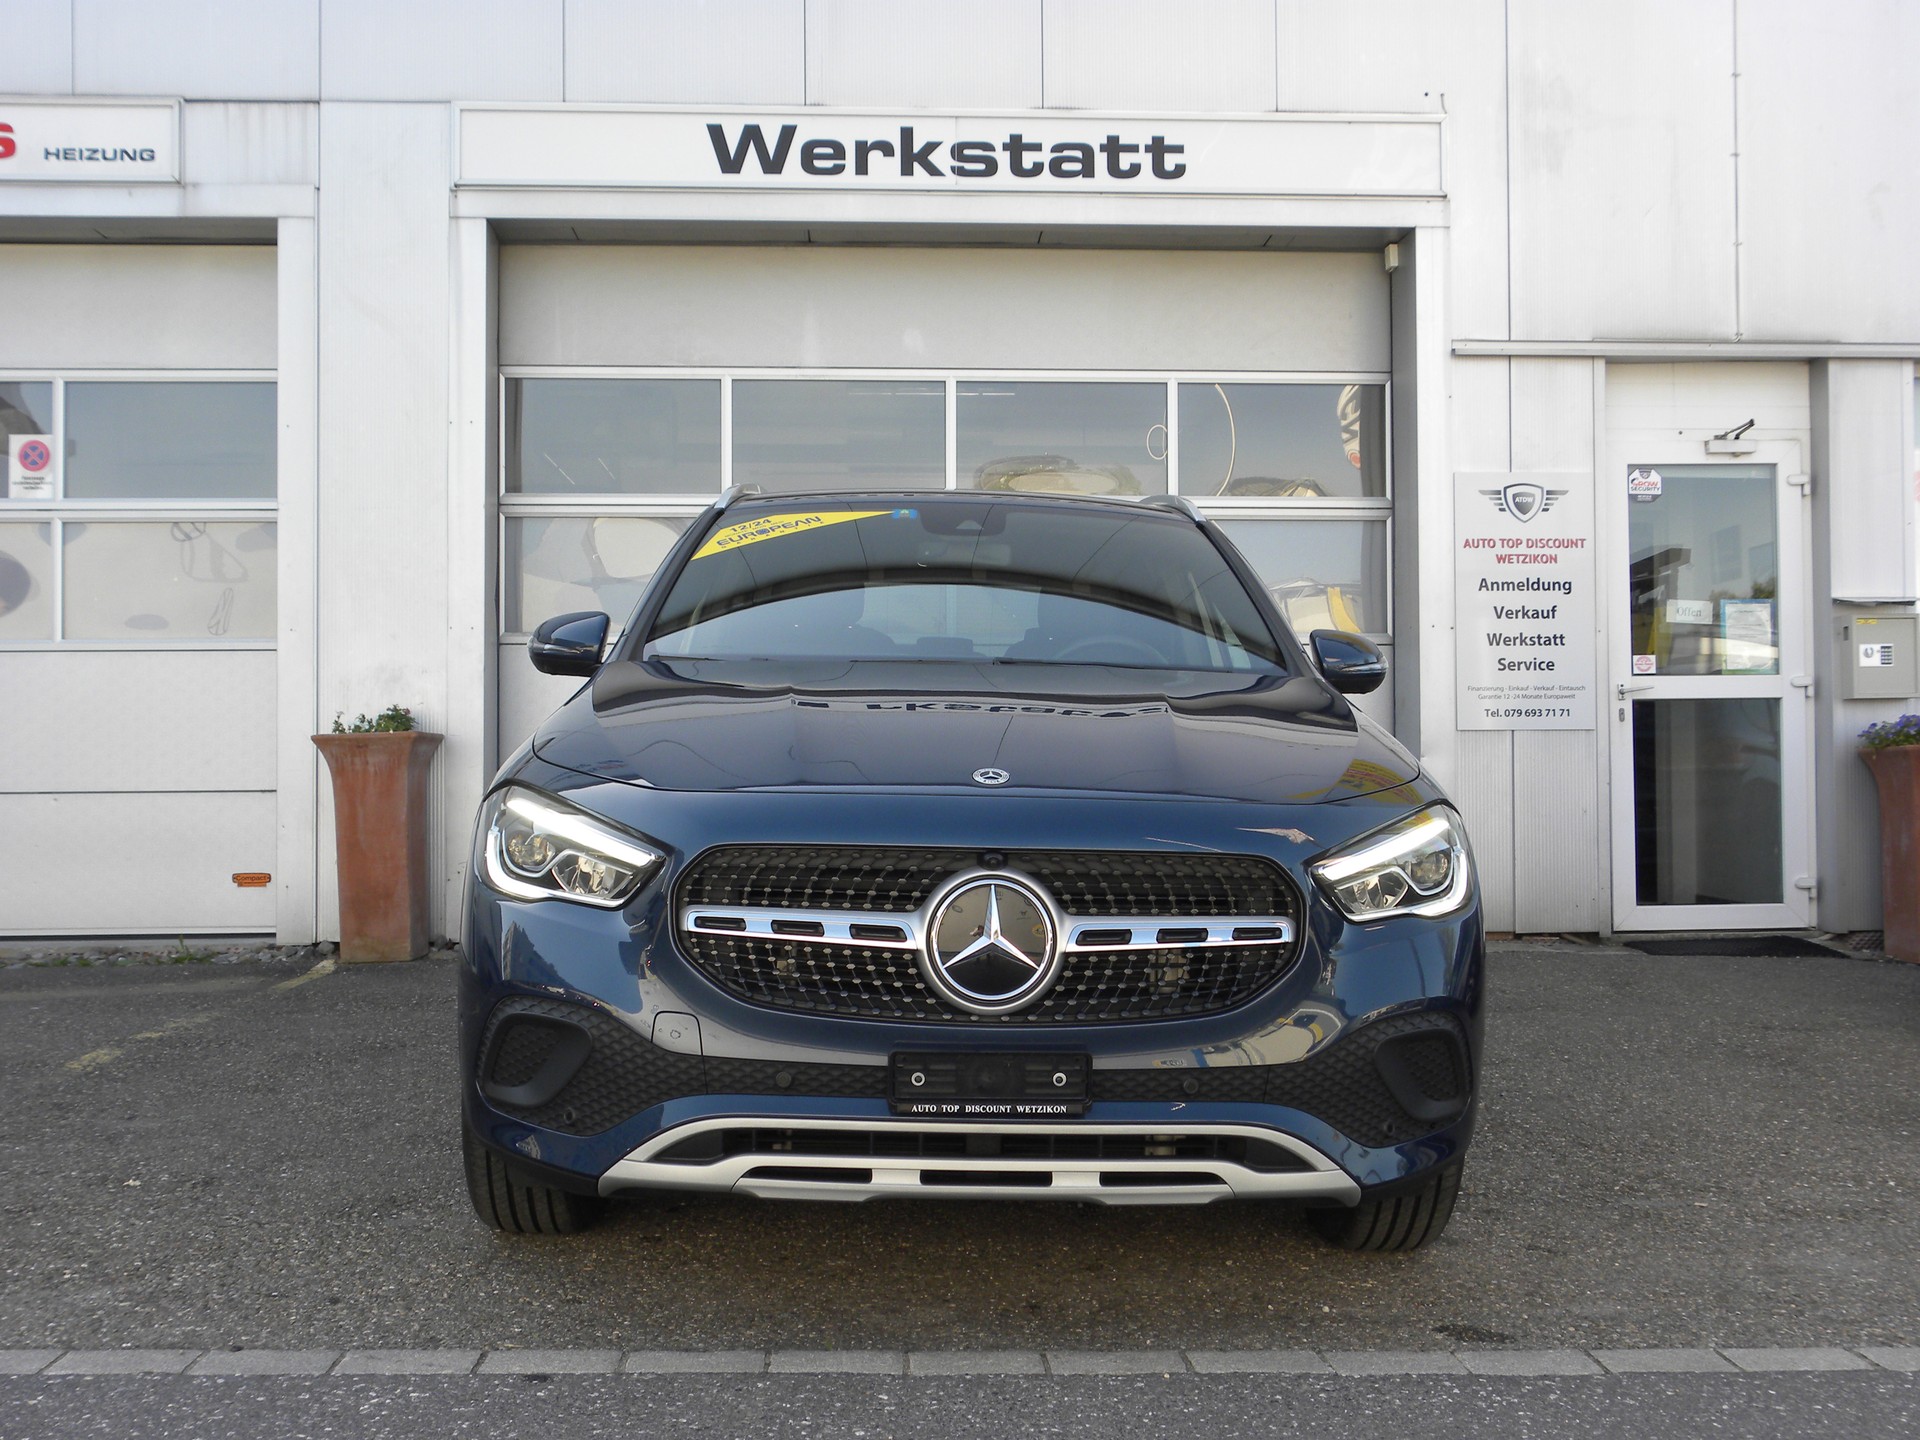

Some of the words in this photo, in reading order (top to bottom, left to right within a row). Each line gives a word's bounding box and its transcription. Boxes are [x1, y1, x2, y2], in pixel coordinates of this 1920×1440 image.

[44, 148, 156, 161] HEIZUNG
[706, 123, 1187, 179] Werkstatt
[717, 516, 822, 545] EUROPEAN
[731, 519, 772, 532] 12/24
[1463, 538, 1496, 549] AUTO
[1499, 538, 1523, 549] TOP
[1526, 538, 1586, 549] DISCOUNT
[1496, 554, 1558, 564] WETZIKON
[1478, 577, 1572, 595] Anmeldung
[1493, 605, 1558, 620] Verkauf
[1676, 606, 1702, 617] Offen
[1487, 632, 1566, 647] Werkstatt
[1497, 657, 1555, 672] Service
[1484, 709, 1503, 717] Tel.
[1504, 709, 1523, 717] 079
[1524, 709, 1543, 717] 693
[1545, 709, 1556, 717] 71
[1559, 709, 1570, 717] 71
[965, 1105, 1012, 1113] DISCOUNT
[1016, 1105, 1067, 1113] WETZIKON
